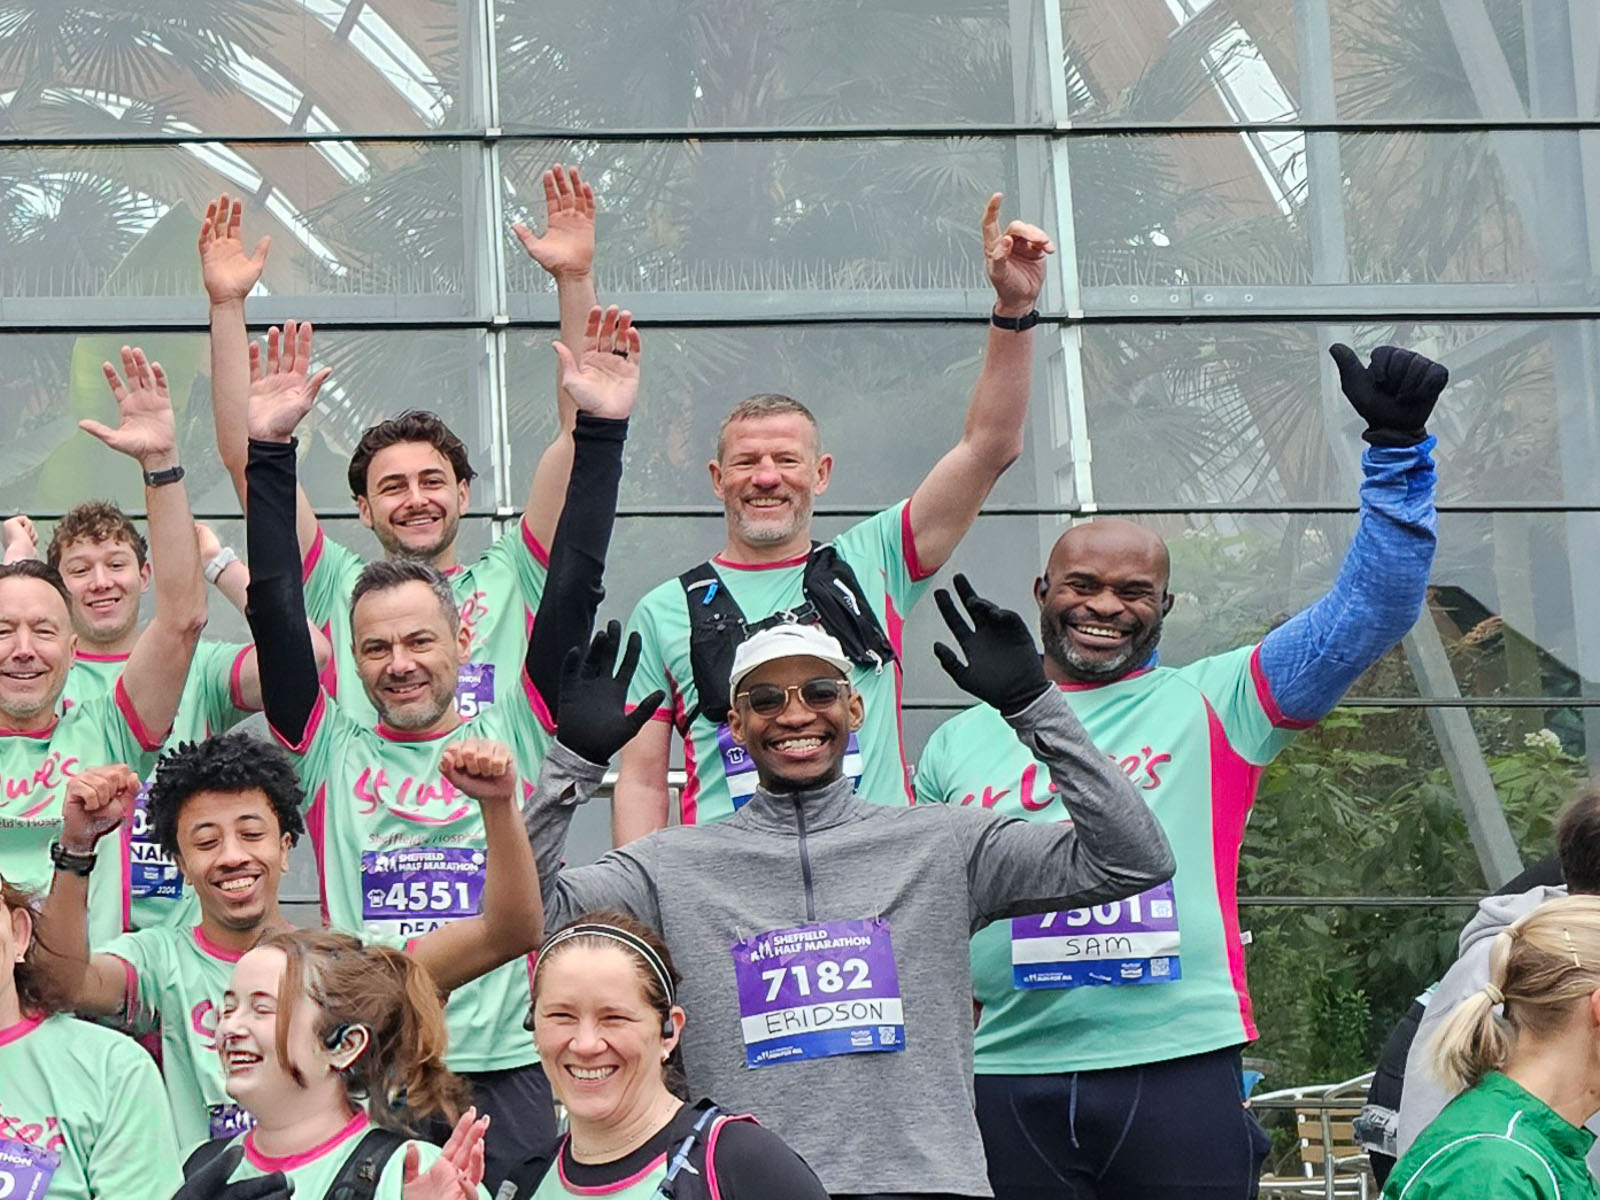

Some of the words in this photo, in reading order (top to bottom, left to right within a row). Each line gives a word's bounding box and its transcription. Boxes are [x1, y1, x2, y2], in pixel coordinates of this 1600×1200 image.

[398, 851, 446, 862] SHEFFIELD
[398, 862, 423, 871] HALF
[423, 861, 479, 872] MARATHON
[384, 880, 471, 912] 4551
[400, 921, 448, 936] DEA
[773, 929, 828, 947] SHEFFIELD
[774, 943, 803, 957] HALF
[805, 935, 872, 953] MARATHON
[1065, 936, 1133, 957] SAM
[762, 957, 873, 1003] 7182
[765, 1001, 884, 1035] ERIDSON
